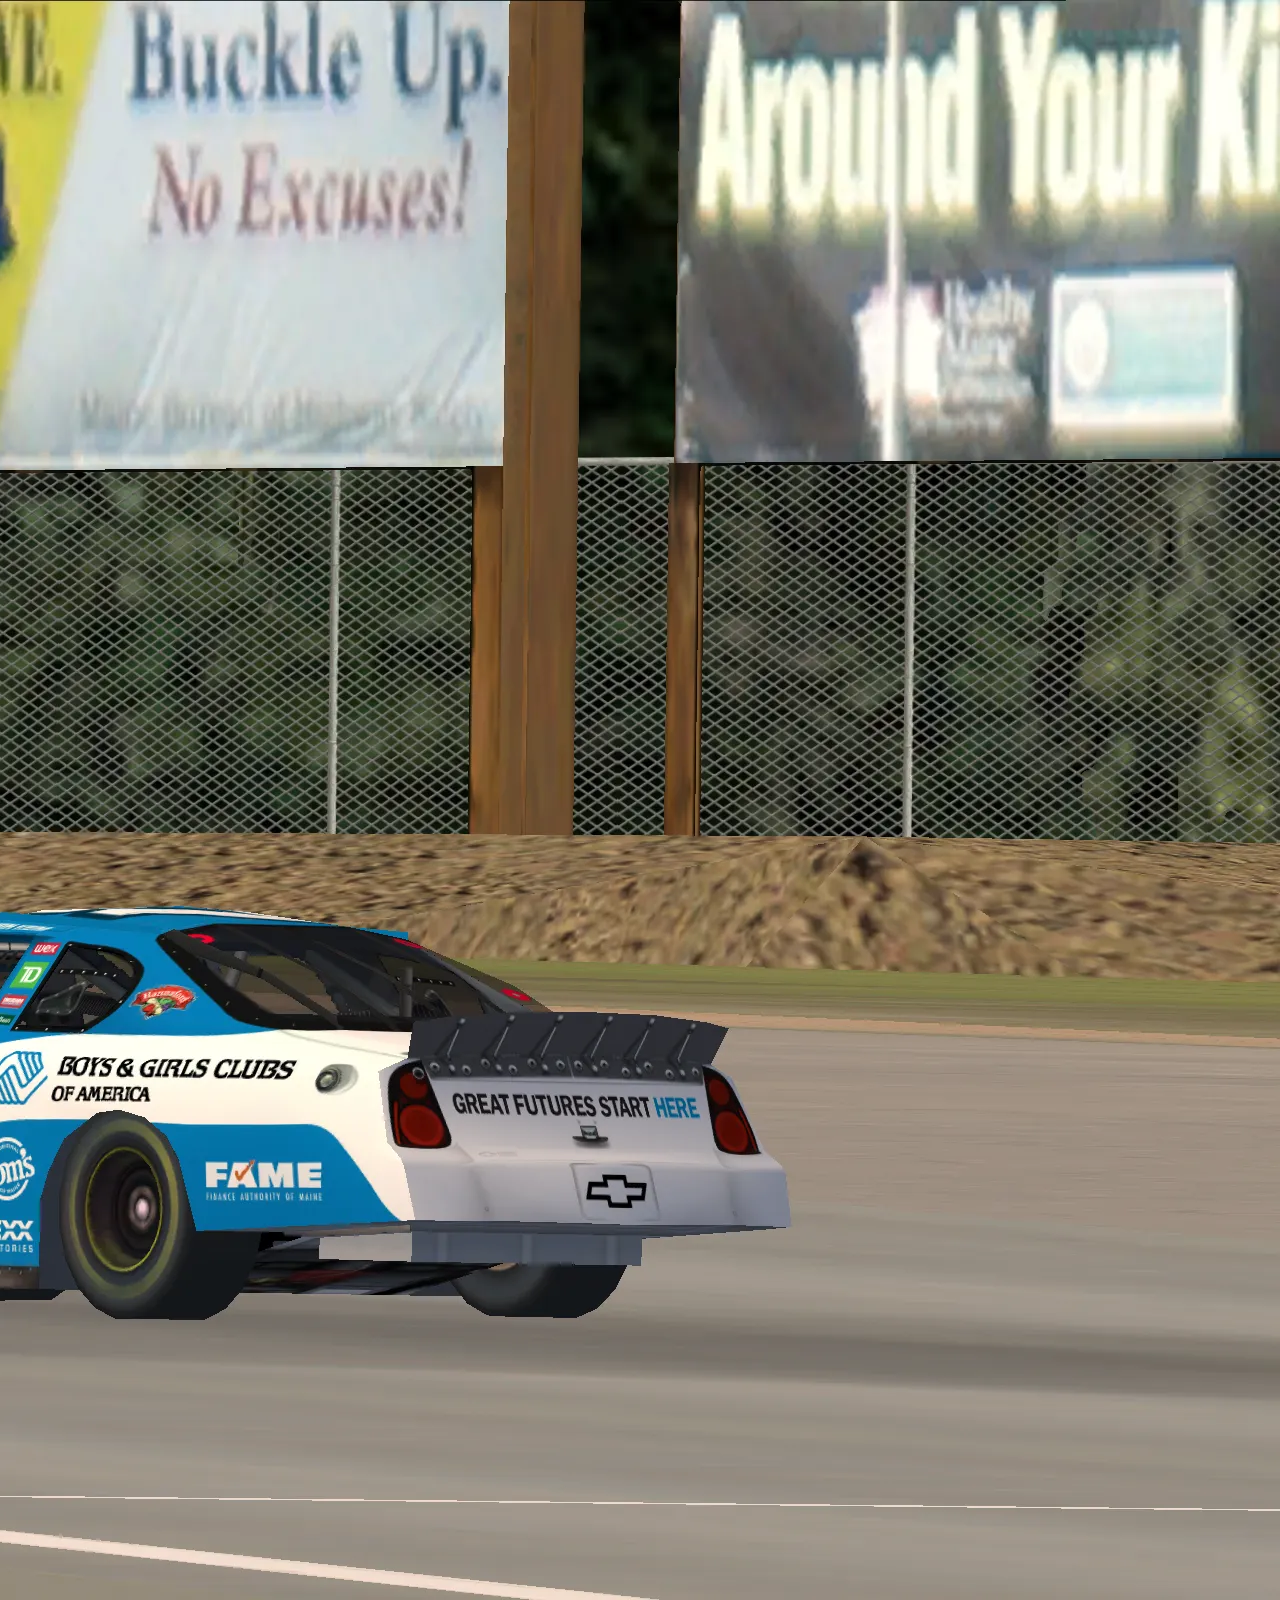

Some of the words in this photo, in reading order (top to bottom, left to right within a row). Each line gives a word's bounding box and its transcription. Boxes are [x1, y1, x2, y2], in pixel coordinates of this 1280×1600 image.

[127, 2, 362, 101] Buckle
[392, 2, 502, 132] Up.
[698, 8, 981, 214] Around
[998, 3, 1184, 206] Your
[148, 143, 221, 237] No
[237, 137, 474, 237] Excuses!
[19, 966, 42, 983] TD
[57, 1056, 116, 1077] BOYS
[116, 1058, 134, 1078] &
[139, 1058, 211, 1079] GIRLS
[213, 1059, 297, 1080] CLUBS
[51, 1085, 75, 1102] OF
[75, 1086, 151, 1102] AMERICA
[452, 1092, 510, 1115] GREAT
[512, 1094, 597, 1117] FUTURES
[598, 1096, 651, 1118] START
[653, 1097, 701, 1119] HERE
[205, 1160, 322, 1188] FAME
[205, 1192, 236, 1201] FINANCE
[240, 1192, 280, 1201] AUTHORITY
[299, 1192, 323, 1201] MAINE
